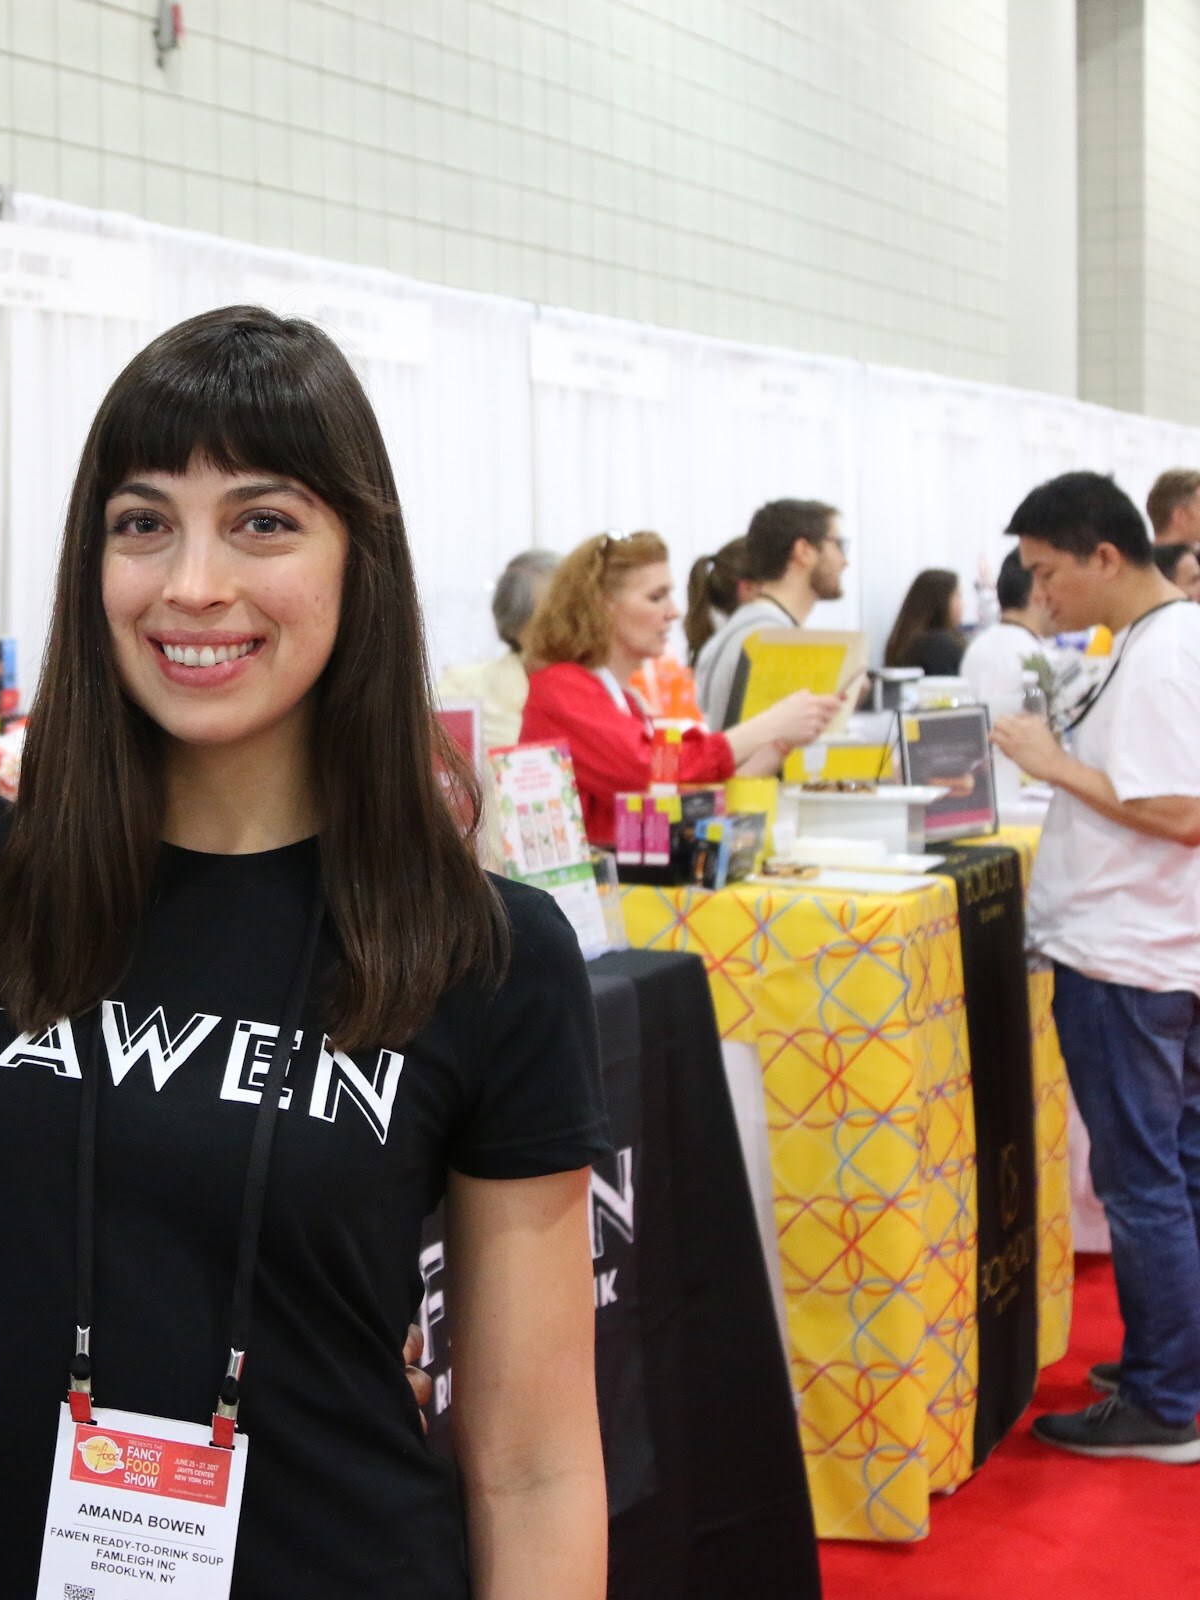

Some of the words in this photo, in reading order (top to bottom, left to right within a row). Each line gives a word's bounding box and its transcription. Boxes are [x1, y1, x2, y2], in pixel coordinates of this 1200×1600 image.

[127, 1445, 162, 1462] FANCY
[125, 1458, 160, 1476] FOOD
[174, 1458, 189, 1466] JUNE
[207, 1463, 219, 1471] 2017
[123, 1471, 158, 1488] SHOW
[187, 1476, 202, 1484] YORK
[202, 1479, 215, 1487] CITY
[194, 1469, 215, 1478] CENTER
[78, 1503, 143, 1525] AMANDA
[147, 1515, 206, 1537] BOWEN
[50, 1527, 90, 1542] FAWEN
[92, 1534, 189, 1560] READY-TO-DRINK
[191, 1552, 224, 1566] SOUP
[96, 1548, 154, 1567] FAMLEIGH
[156, 1559, 177, 1571] INC
[90, 1560, 157, 1582] BROOKLYN,
[159, 1574, 177, 1585] NY
